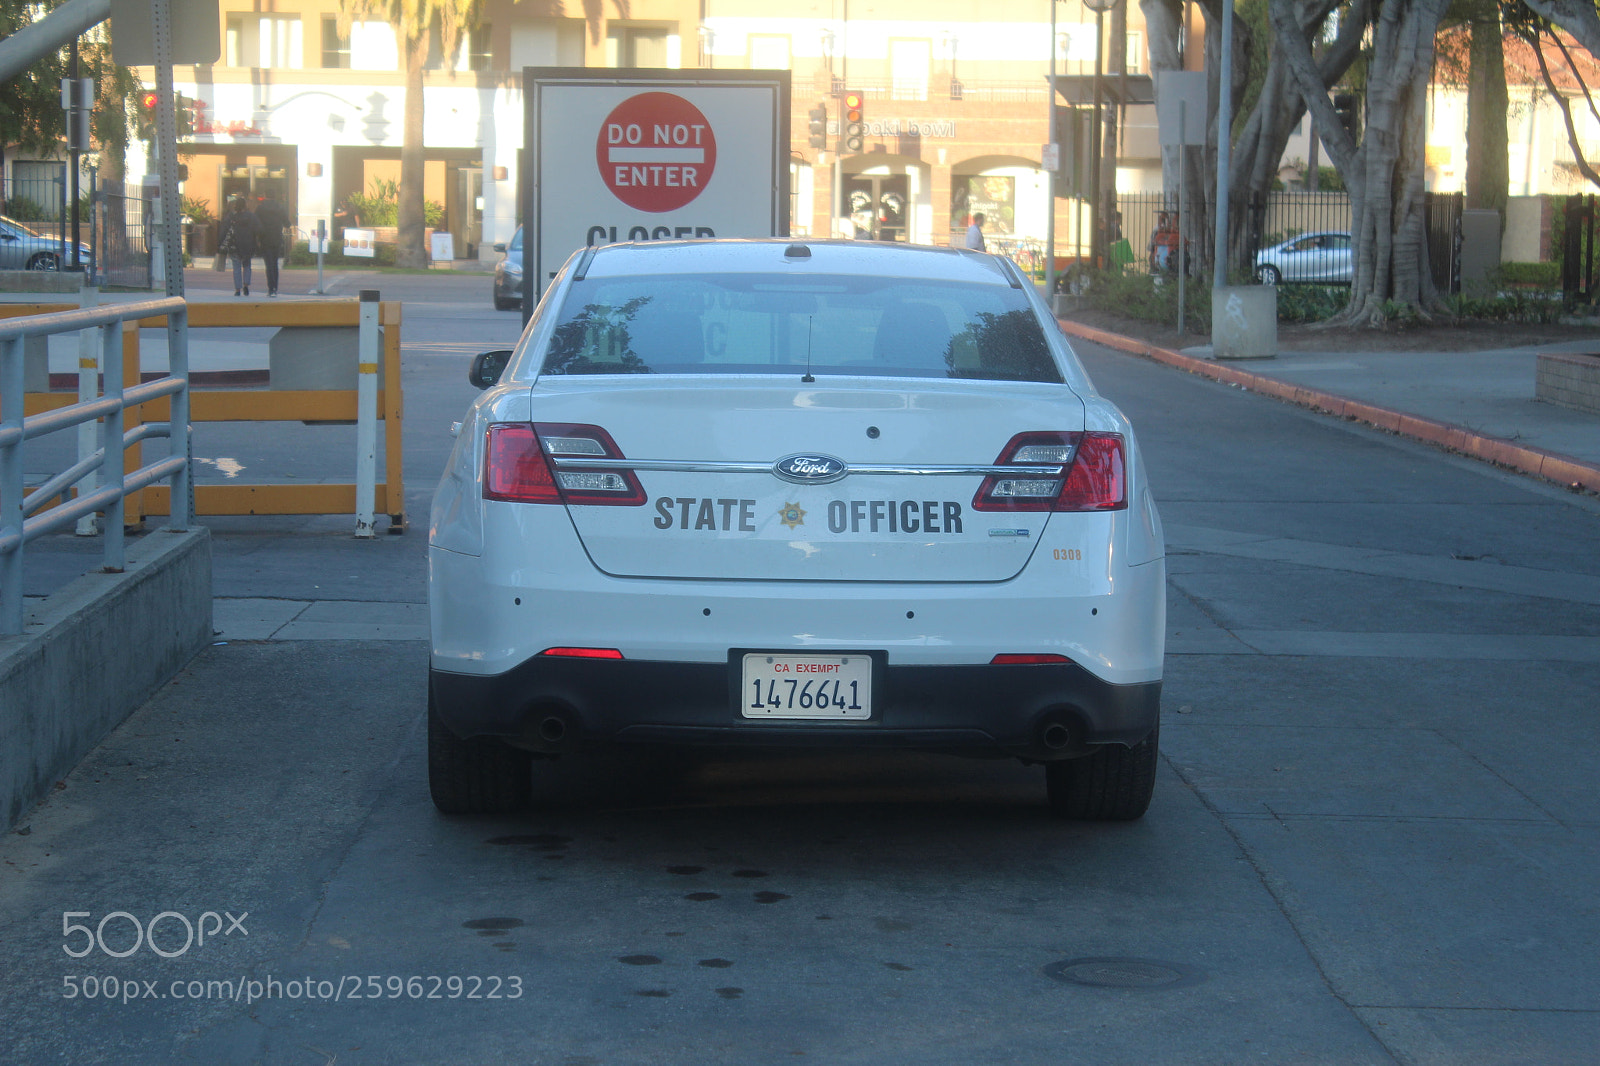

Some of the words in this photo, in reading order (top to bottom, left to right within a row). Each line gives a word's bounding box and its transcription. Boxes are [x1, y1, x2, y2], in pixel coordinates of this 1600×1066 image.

[608, 123, 642, 144] DO
[653, 124, 705, 145] NOT
[907, 119, 955, 137] bowl
[615, 166, 697, 187] ENTER
[790, 457, 830, 473] Ford
[653, 496, 756, 532] STATE
[827, 500, 963, 534] OFFICER
[1053, 548, 1082, 561] 0308
[774, 663, 790, 673] CA
[796, 663, 841, 673] EXEMPT
[751, 678, 862, 710] 1476641
